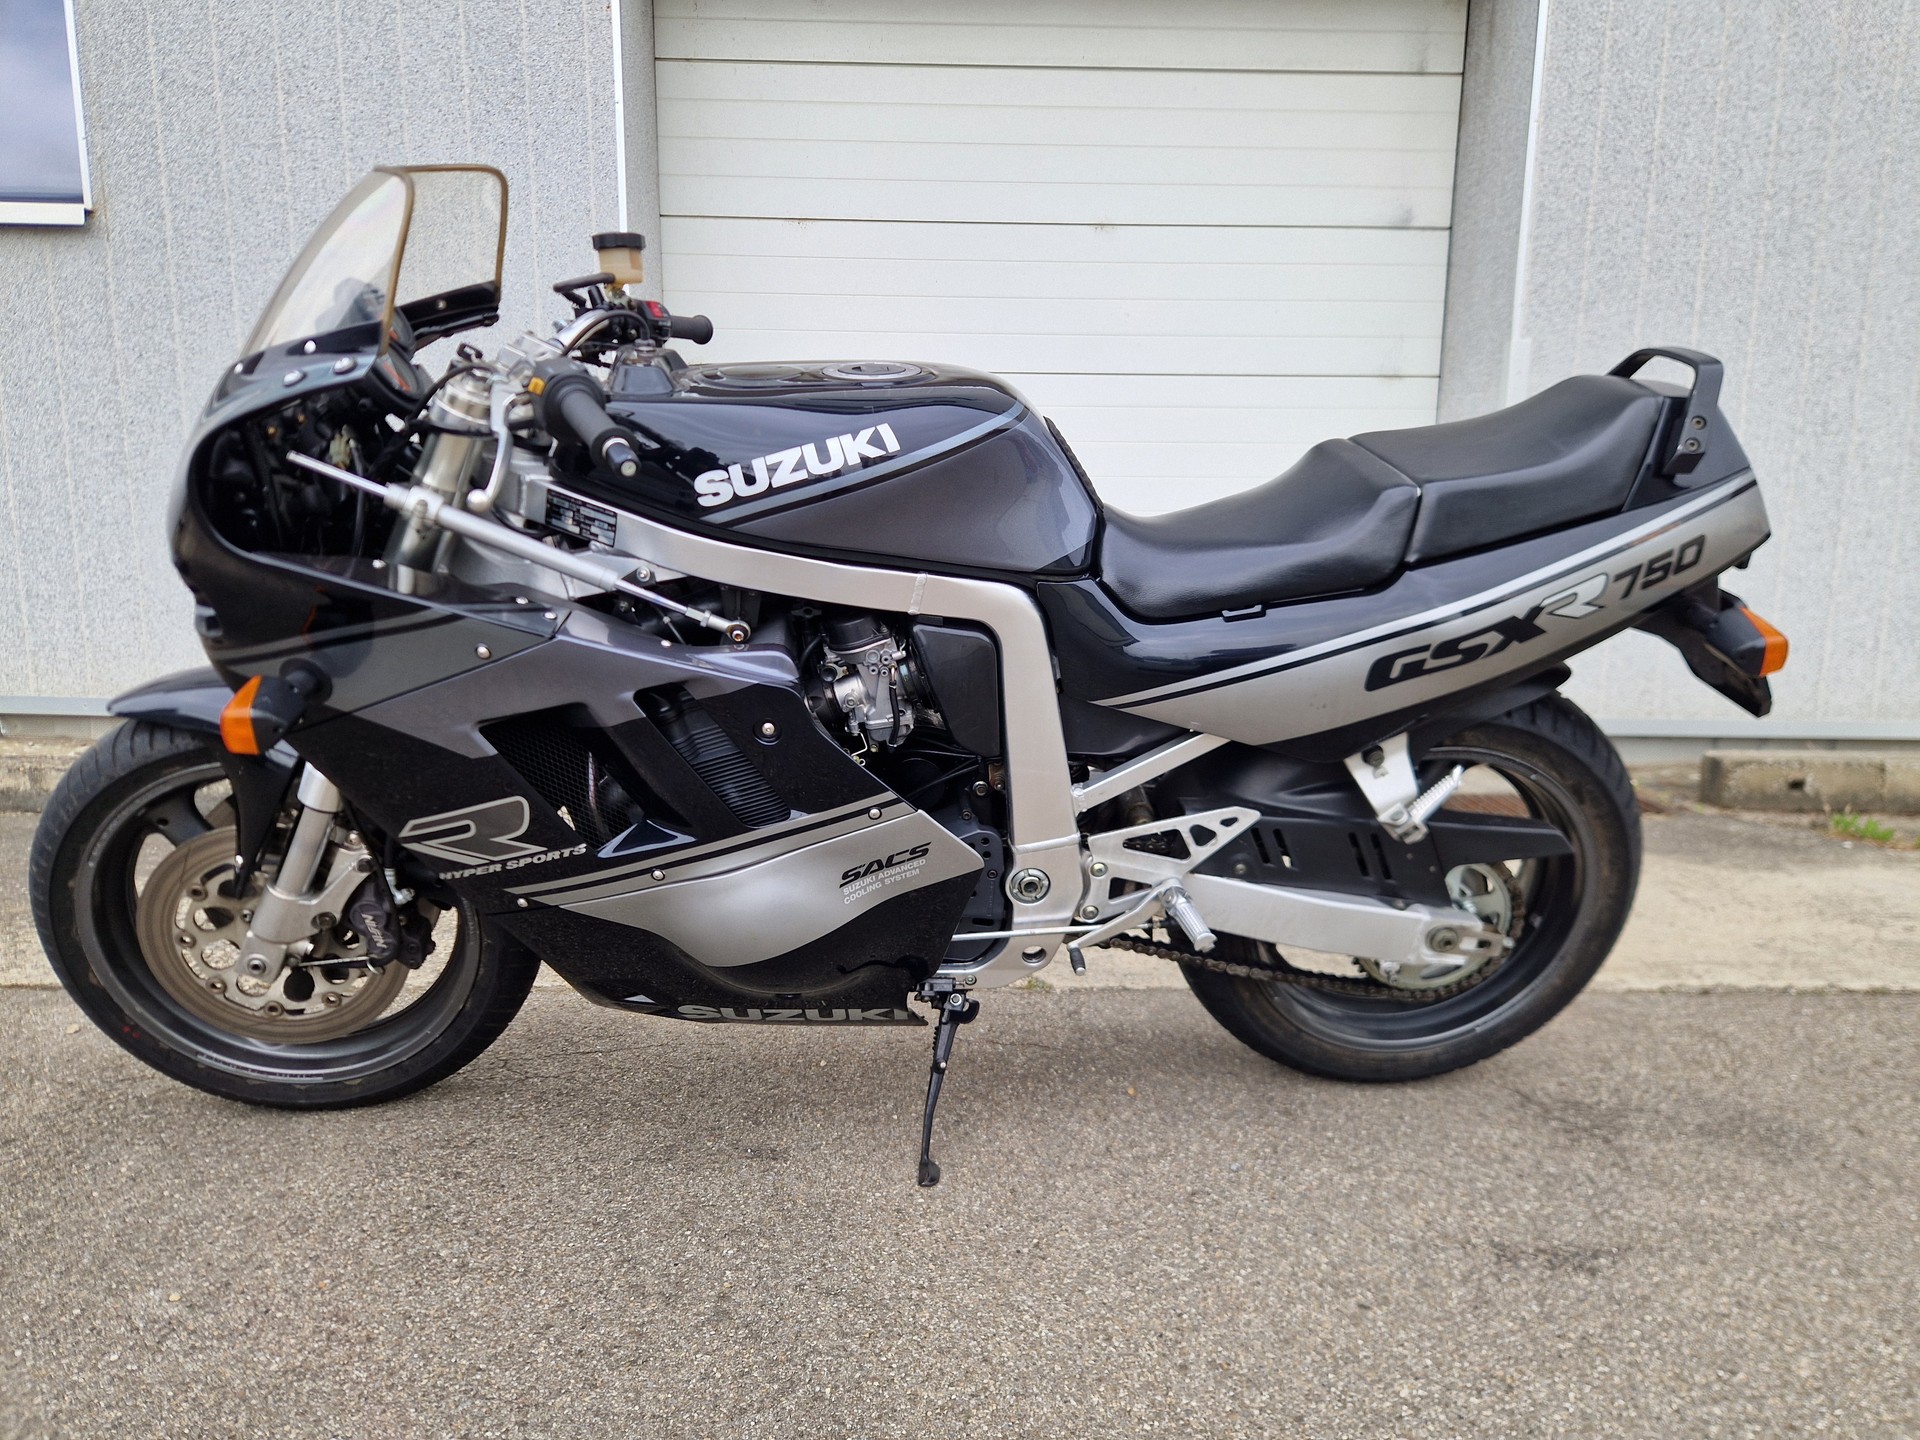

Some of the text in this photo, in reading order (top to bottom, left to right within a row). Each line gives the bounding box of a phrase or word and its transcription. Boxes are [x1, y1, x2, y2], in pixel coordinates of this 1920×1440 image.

[694, 423, 901, 507] SUZUKI
[1612, 534, 1706, 600] 750
[438, 843, 588, 881] HYPER SPORTS
[839, 841, 932, 889] SACS
[843, 858, 927, 896] SUZUKI ADVANCED
[843, 868, 920, 905] COOLING SYSTEM
[677, 1004, 909, 1022] SUZUKI
